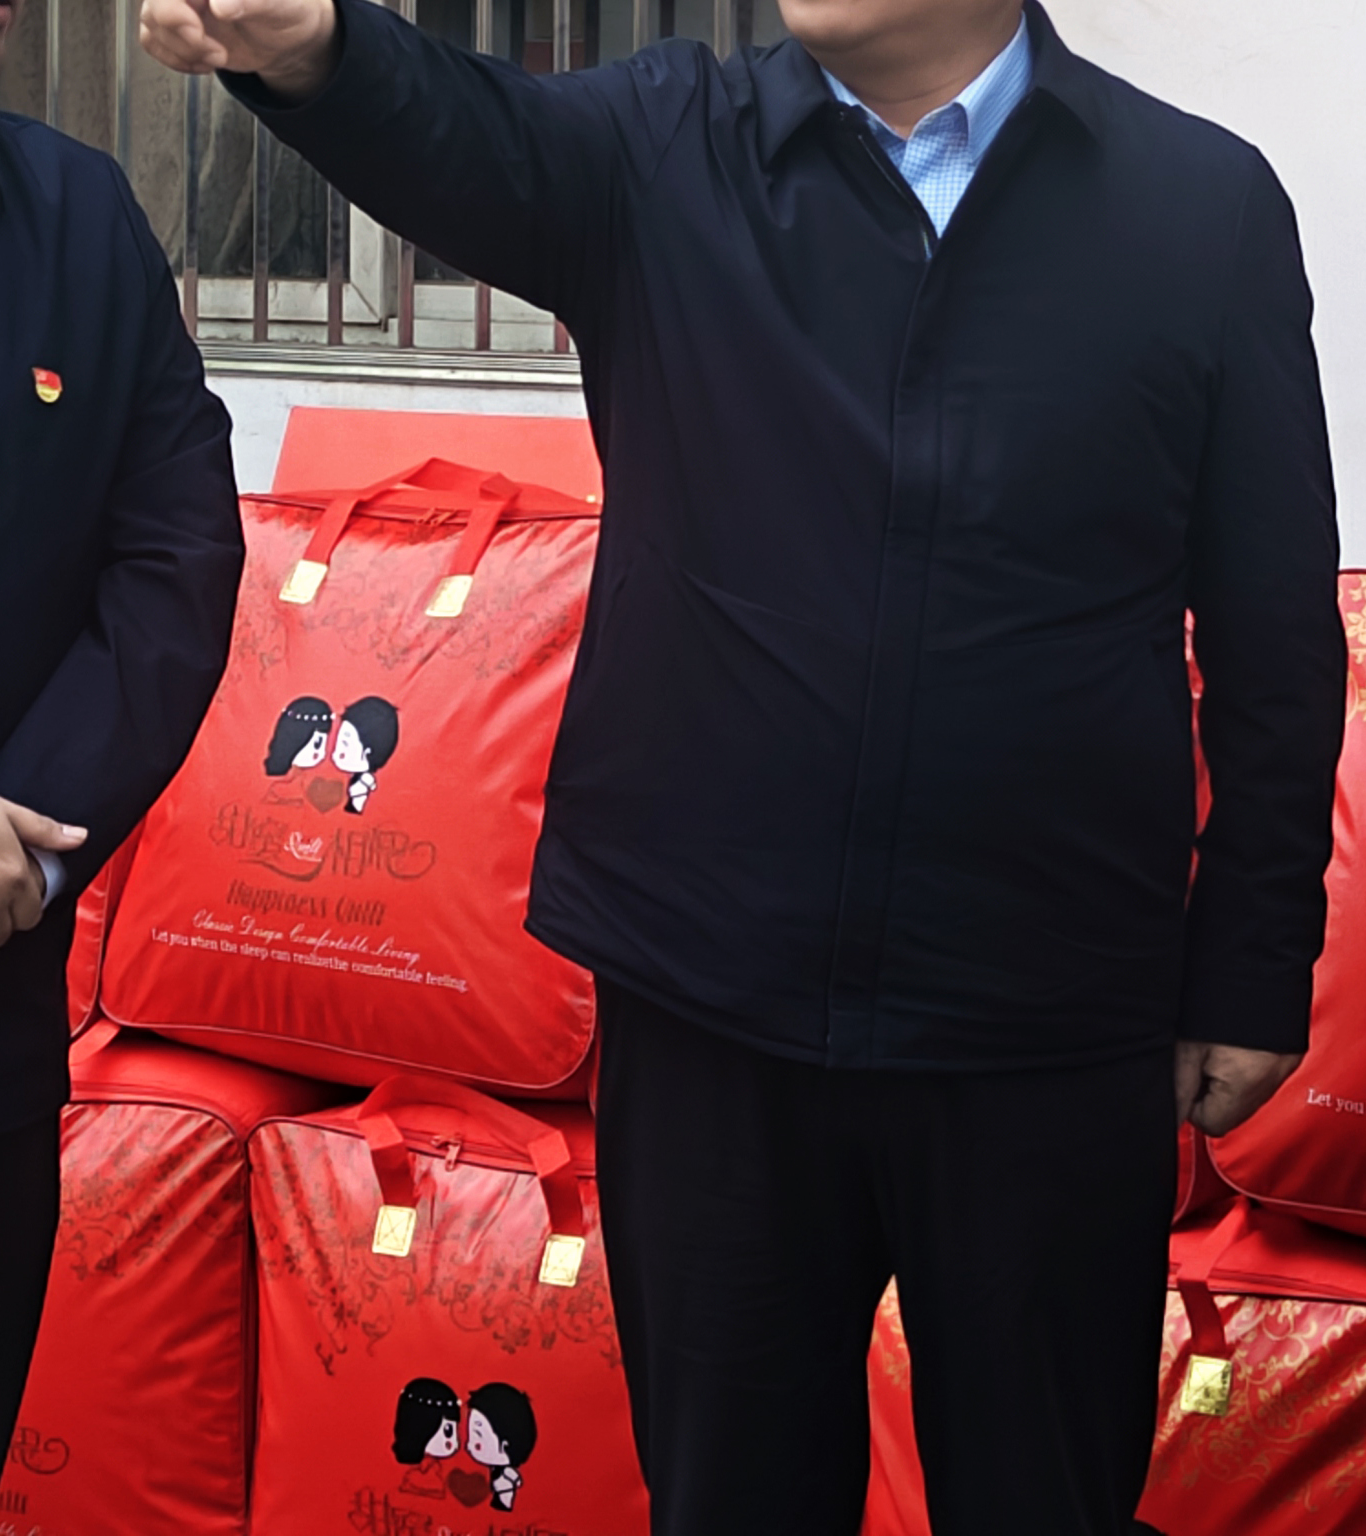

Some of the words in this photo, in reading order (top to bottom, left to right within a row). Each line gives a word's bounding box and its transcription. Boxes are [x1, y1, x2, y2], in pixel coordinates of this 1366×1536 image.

[152, 927, 168, 942] Let
[169, 933, 188, 947] you
[191, 935, 218, 952] when
[219, 938, 238, 954] the
[240, 943, 269, 961] sleep
[270, 949, 292, 963] can
[351, 961, 424, 984] comfortable
[289, 922, 370, 954] Comfortable
[370, 936, 421, 971] Living
[1306, 1087, 1333, 1107] Let
[1335, 1095, 1365, 1114] you
